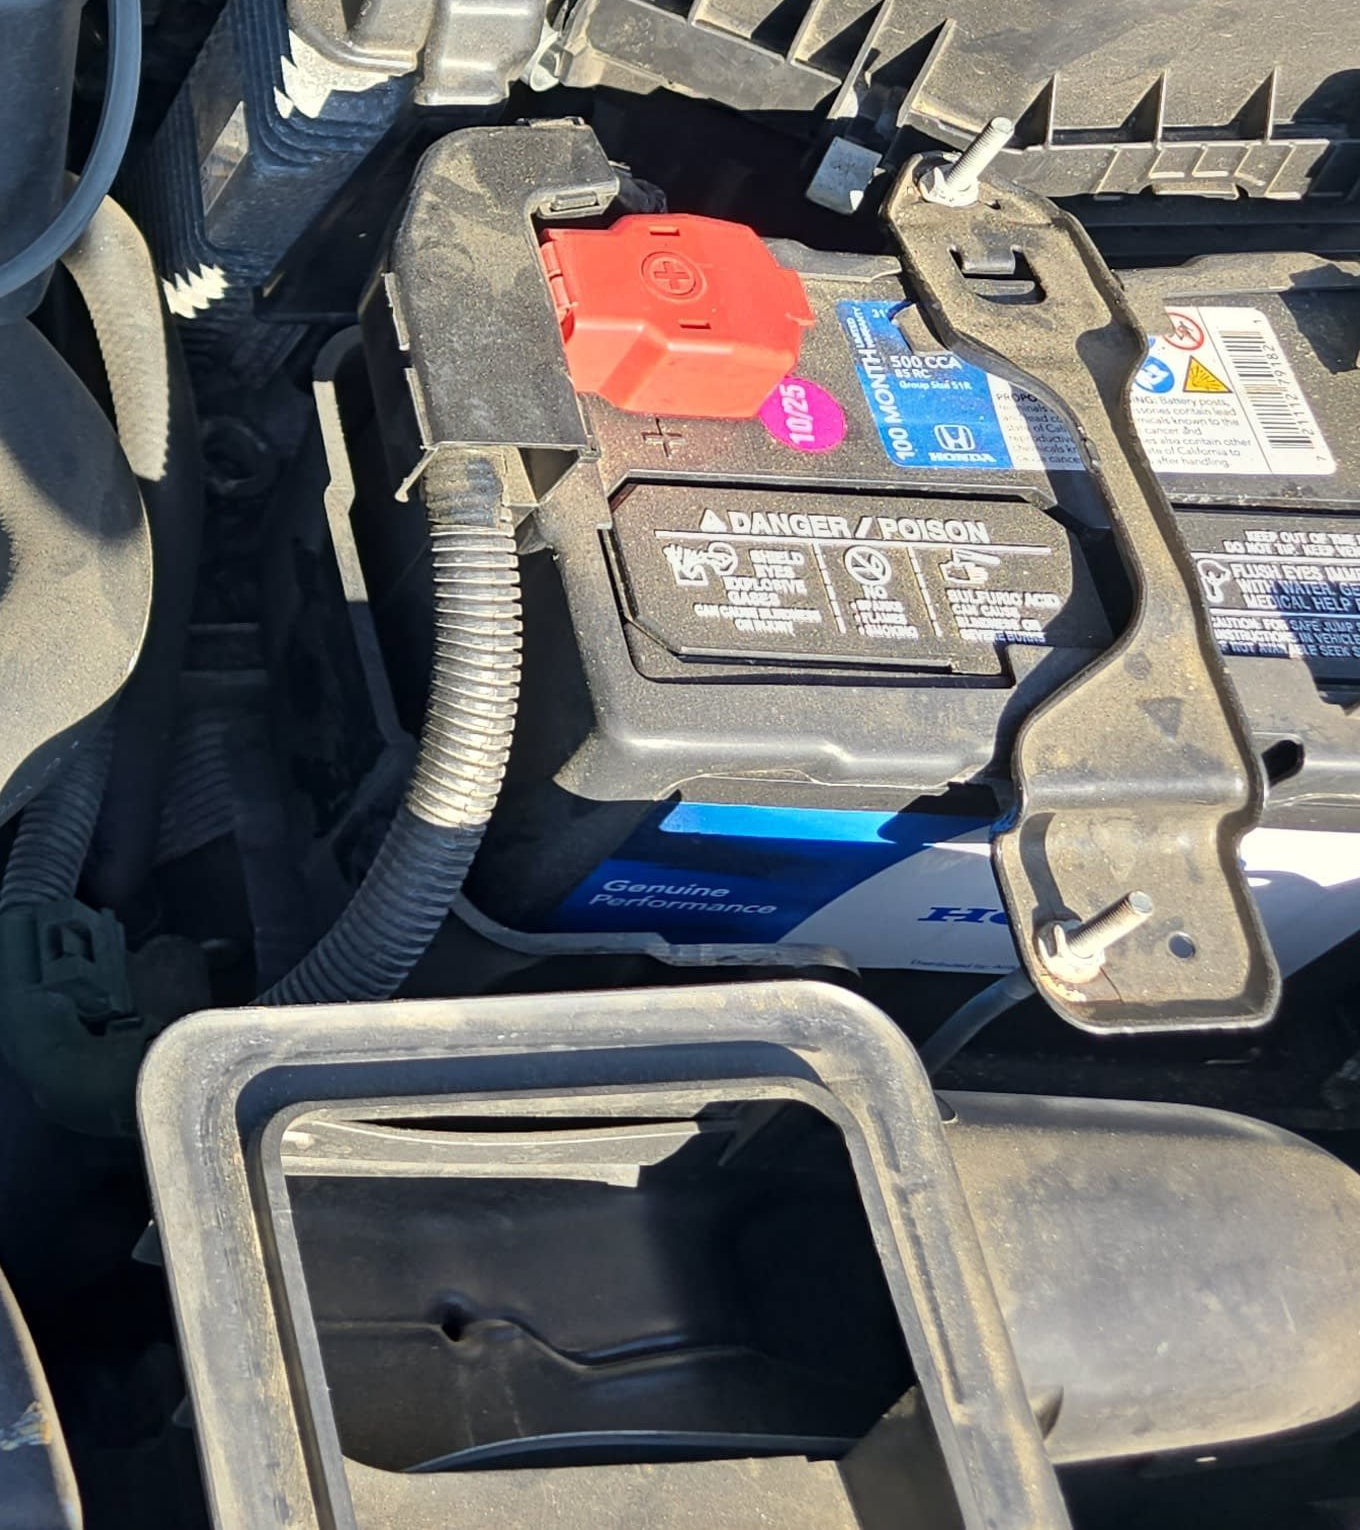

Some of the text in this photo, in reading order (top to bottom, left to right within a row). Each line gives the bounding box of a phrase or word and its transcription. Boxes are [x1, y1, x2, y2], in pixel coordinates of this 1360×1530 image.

[889, 355, 963, 370] 500 CCA
[1262, 343, 1292, 387] 79182
[912, 369, 933, 379] RC
[899, 380, 930, 390] Group
[858, 348, 917, 461] 100 MONTH
[779, 384, 817, 444] 10/25
[1285, 392, 1316, 436] 21112
[930, 452, 997, 463] HONDA
[1176, 446, 1228, 457] California
[727, 511, 851, 539] DANGER
[878, 517, 991, 544] POISON
[1245, 530, 1357, 546] KEEP OUT OF THE
[1223, 540, 1245, 553] DO
[1245, 541, 1273, 555] NOT
[1301, 544, 1335, 557] KEEP
[1230, 562, 1282, 579] FLUSH
[1282, 565, 1324, 581] EYES
[723, 576, 808, 595] EXPLOSIVE
[862, 584, 888, 600] NO
[1236, 578, 1278, 594] WITH
[727, 590, 781, 607] GASES
[946, 588, 1062, 609] SULFURIC ACID
[1242, 593, 1353, 612] MEDICAL HELP
[951, 603, 1021, 620] CAN CAUSE
[1021, 618, 1043, 632] OR
[1262, 618, 1289, 631] FOR
[1290, 620, 1321, 633] SAFE
[1322, 621, 1355, 634] JUMP
[1006, 630, 1048, 644] BURNS
[1298, 633, 1314, 644] IN
[1231, 641, 1256, 654] NOT
[1320, 645, 1352, 658] SEEK
[602, 878, 731, 898] Genuine
[588, 892, 778, 915] Performance
